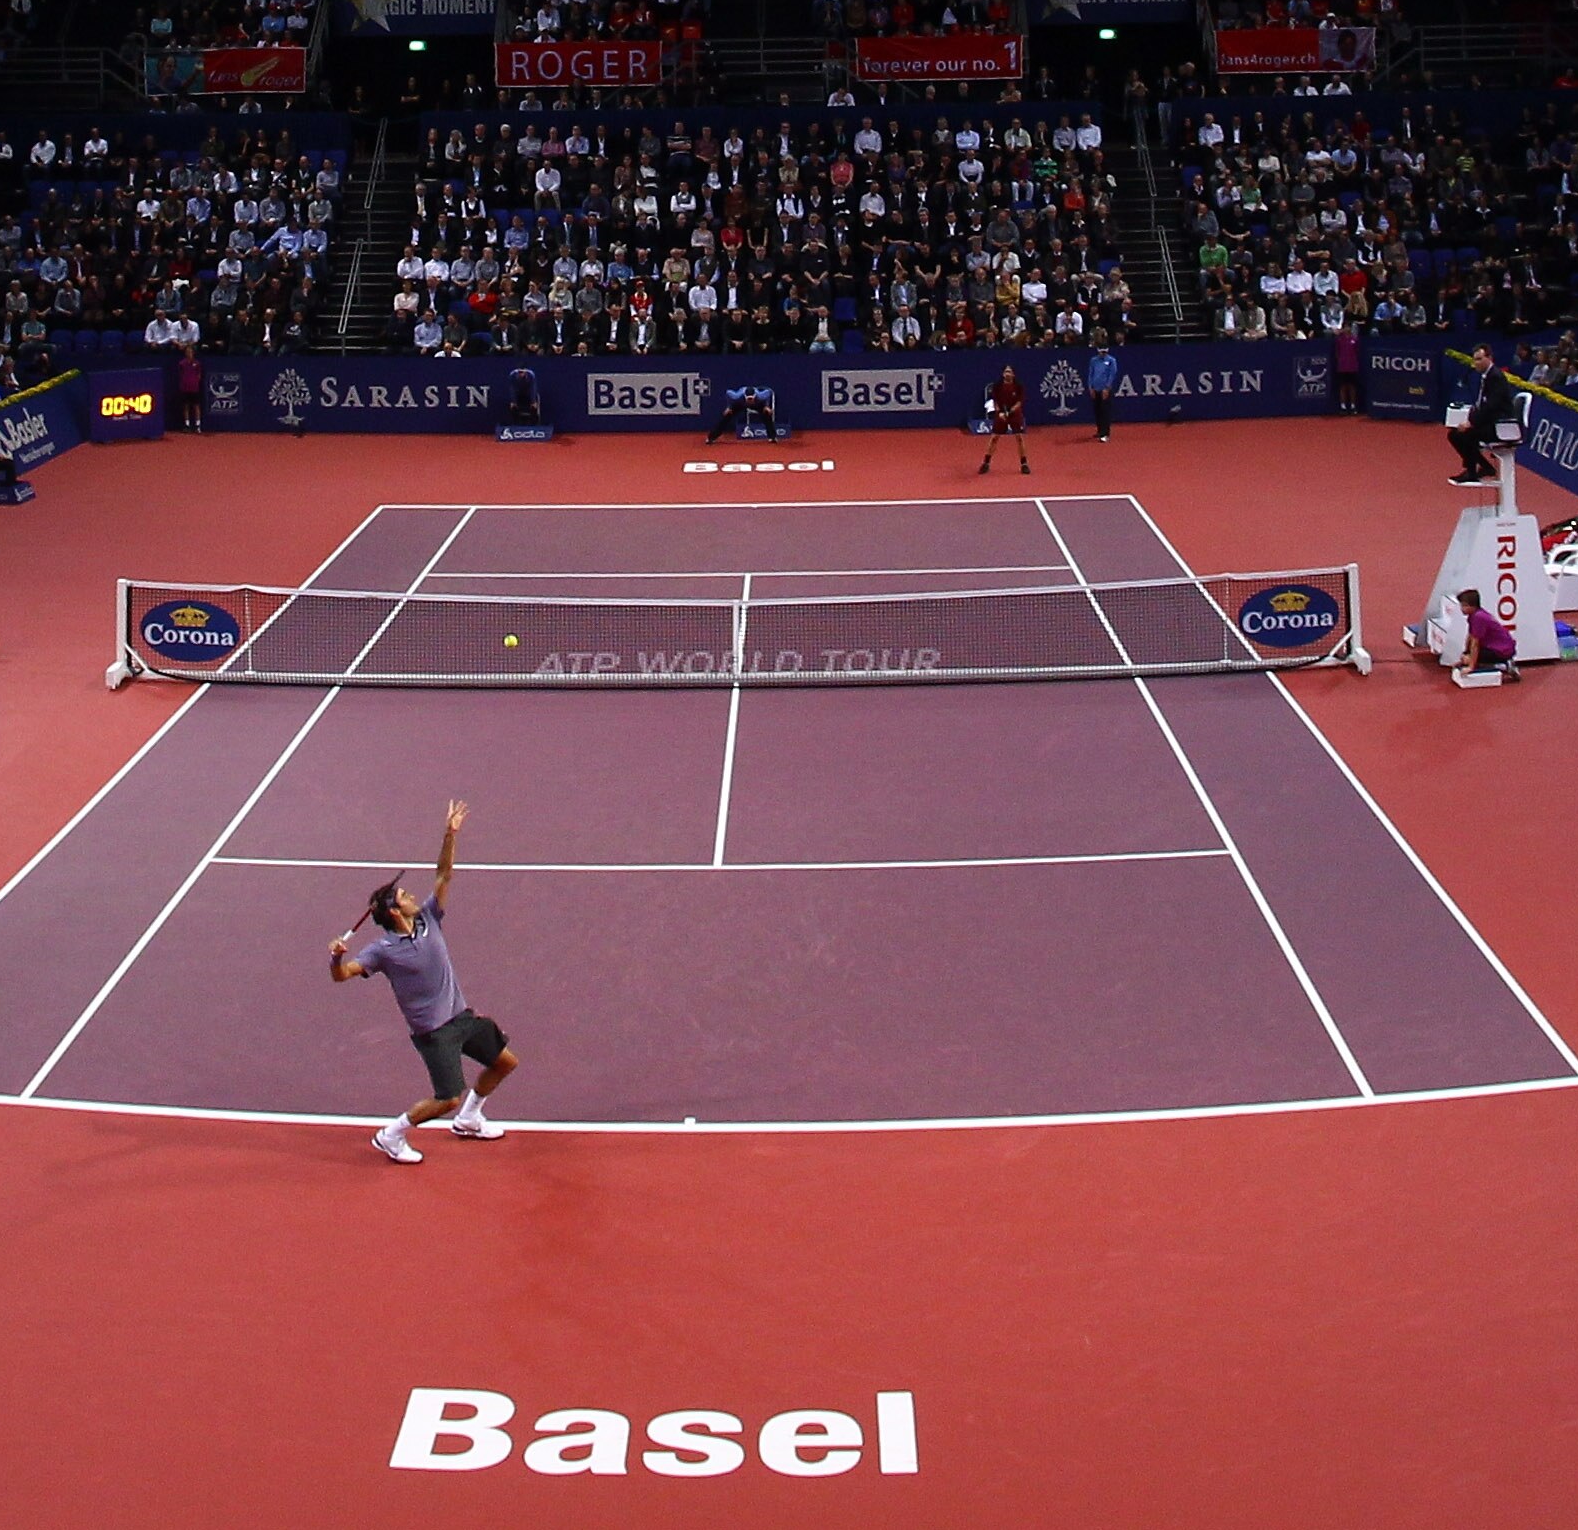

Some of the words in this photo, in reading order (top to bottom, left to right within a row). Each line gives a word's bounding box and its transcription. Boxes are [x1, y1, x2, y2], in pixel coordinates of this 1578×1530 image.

[512, 50, 647, 80] ROGER
[935, 60, 967, 72] our
[972, 59, 1001, 71] no.
[1004, 41, 1016, 71] 1
[1371, 356, 1430, 372] RICOH
[320, 376, 492, 409] SARASIN
[593, 375, 691, 411] Basel
[827, 372, 924, 408] Basel
[1115, 370, 1265, 397] ARASIN
[100, 393, 153, 417] 00:40
[210, 400, 239, 410] ATP
[683, 459, 835, 473] Basel
[1241, 607, 1334, 634] Corona
[144, 622, 235, 649] Corona
[530, 652, 621, 677] ATP
[636, 650, 805, 675] WORLD
[822, 647, 943, 673] TOUR
[388, 1386, 919, 1478] Basel
